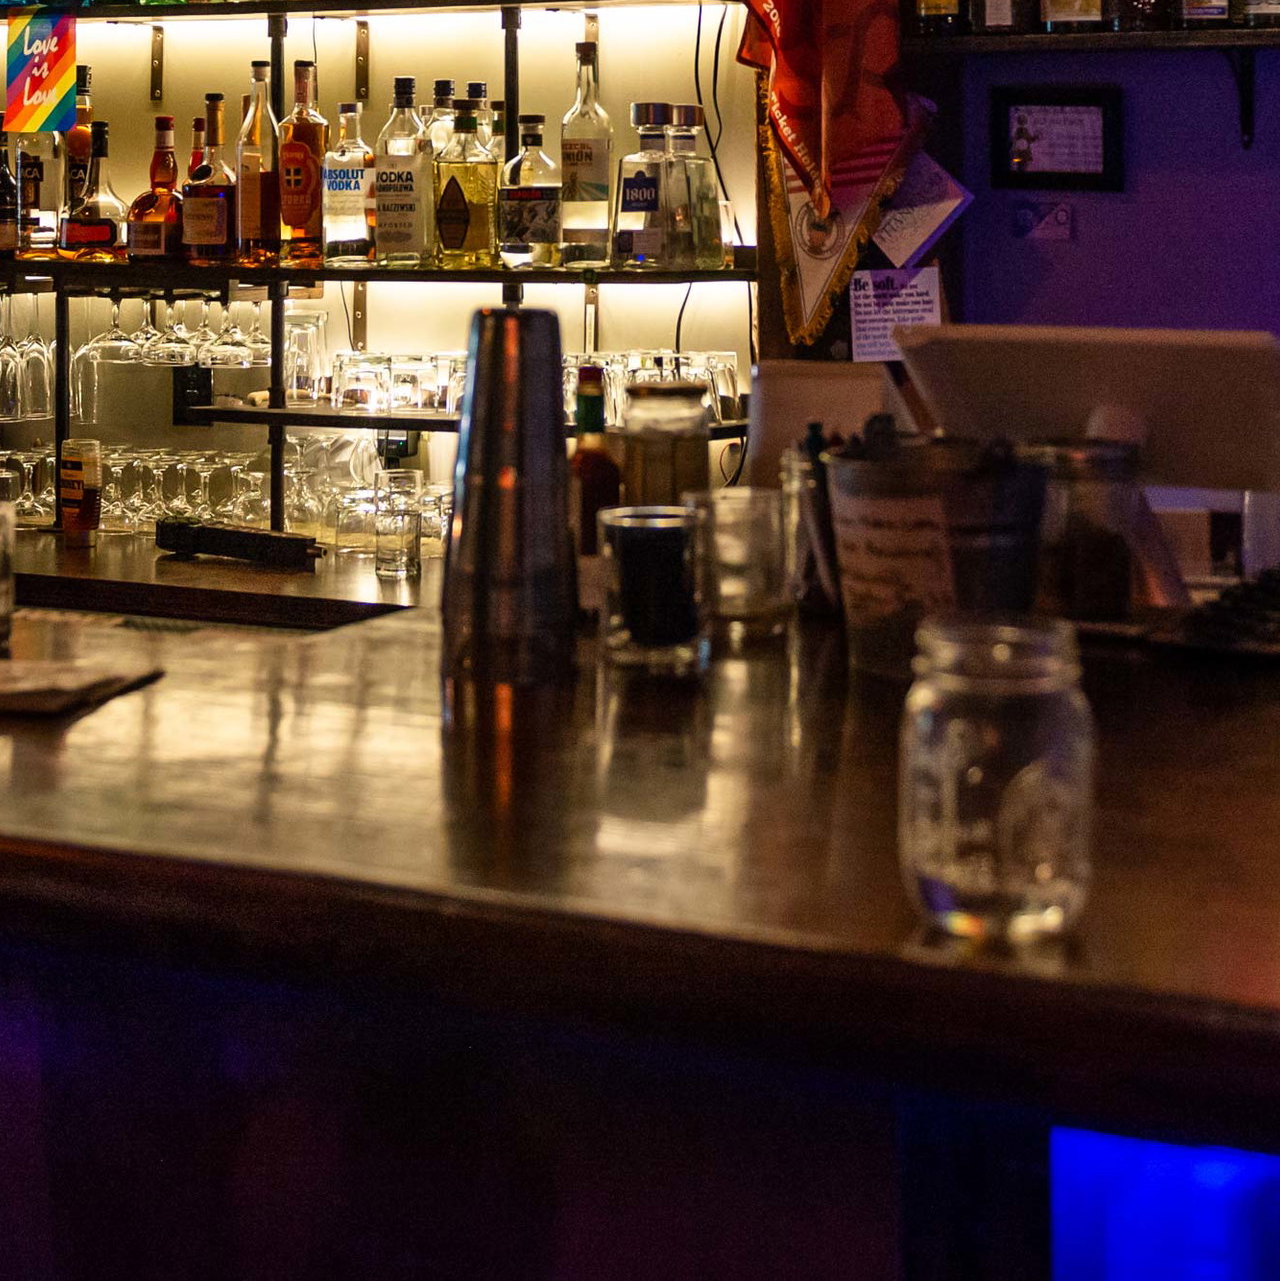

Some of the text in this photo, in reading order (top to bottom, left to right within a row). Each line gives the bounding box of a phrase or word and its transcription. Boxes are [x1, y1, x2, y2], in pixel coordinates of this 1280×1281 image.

[23, 26, 59, 56] Love
[32, 57, 49, 77] is
[23, 77, 59, 107] Love
[323, 169, 365, 180] ABSOLUT
[327, 180, 361, 191] VODKA
[625, 187, 656, 201] 1800
[853, 278, 869, 292] Be
